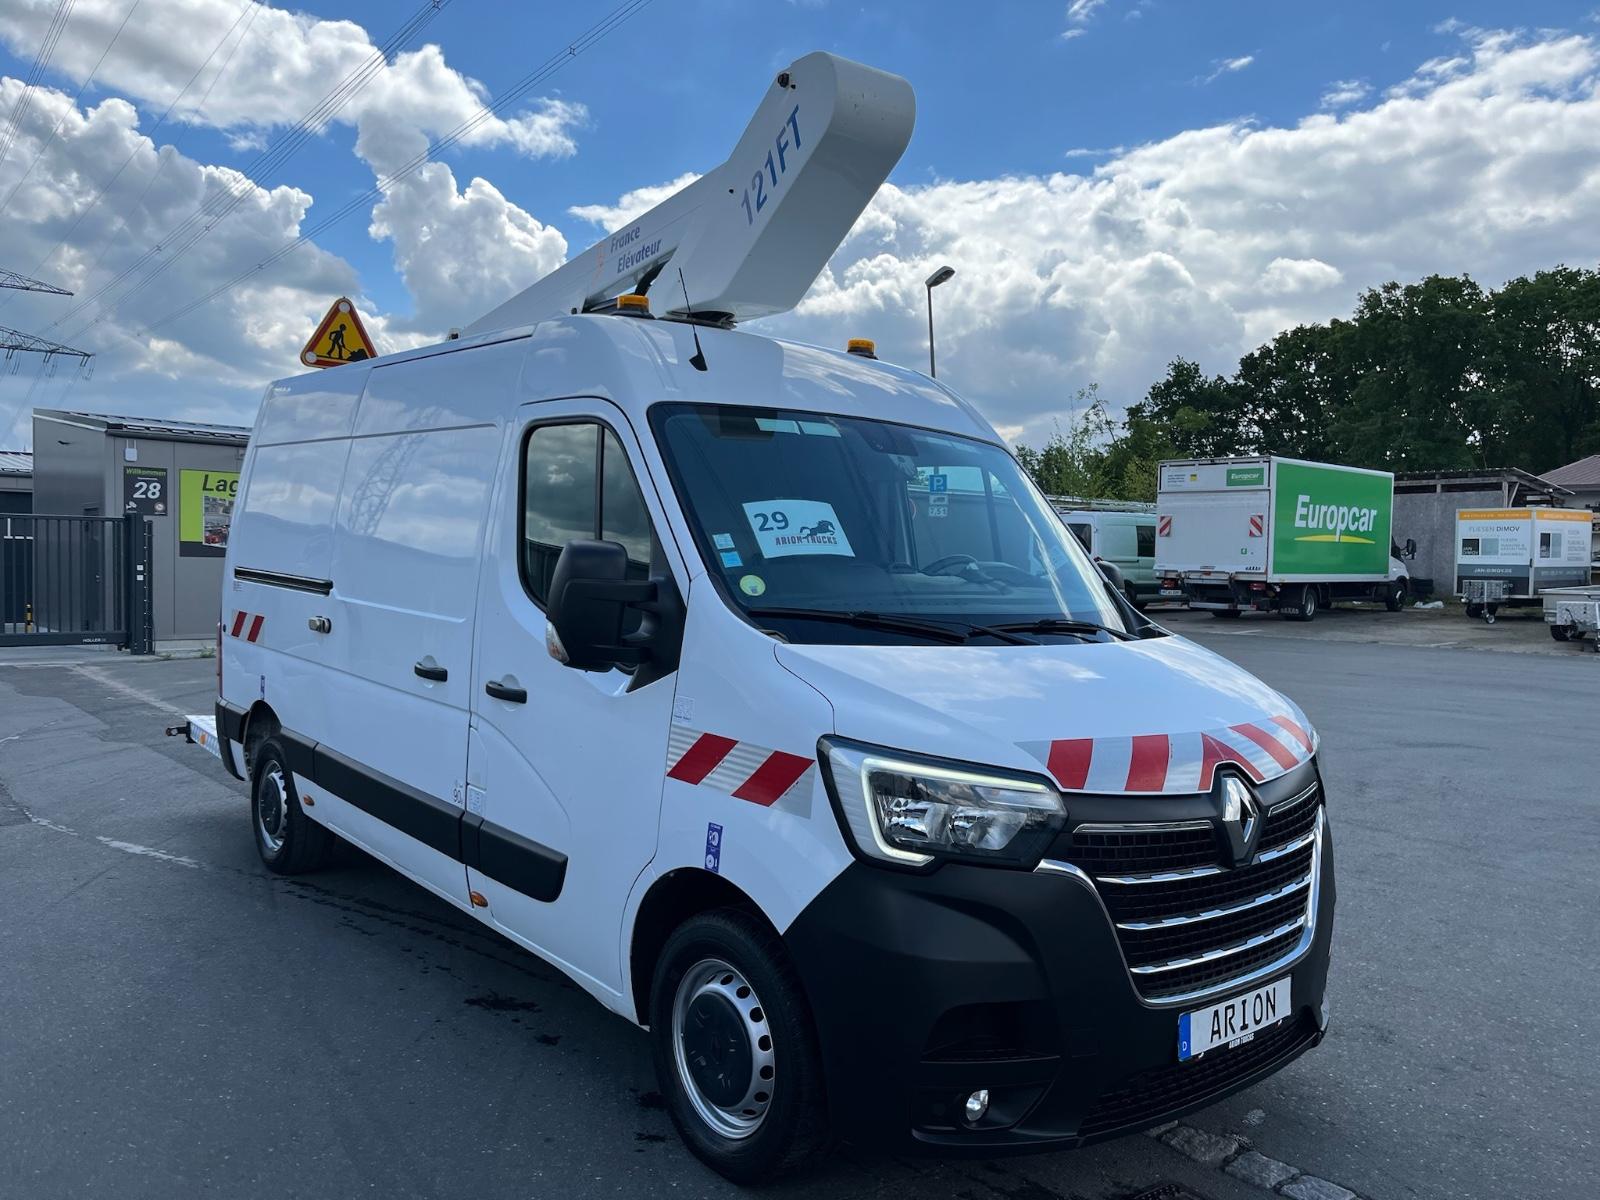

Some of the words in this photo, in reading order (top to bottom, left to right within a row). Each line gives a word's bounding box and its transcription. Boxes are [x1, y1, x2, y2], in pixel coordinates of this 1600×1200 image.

[741, 104, 801, 226] 121FT
[610, 226, 641, 253] France
[617, 239, 662, 274] Elévateur
[1231, 473, 1260, 481] Europcar
[133, 481, 162, 499] 28
[753, 511, 790, 532] 29
[1295, 494, 1377, 542] Europcar
[775, 536, 803, 546] ARION
[807, 535, 838, 545] TRUCKS
[1210, 987, 1276, 1043] ARION
[1182, 1040, 1188, 1051] D
